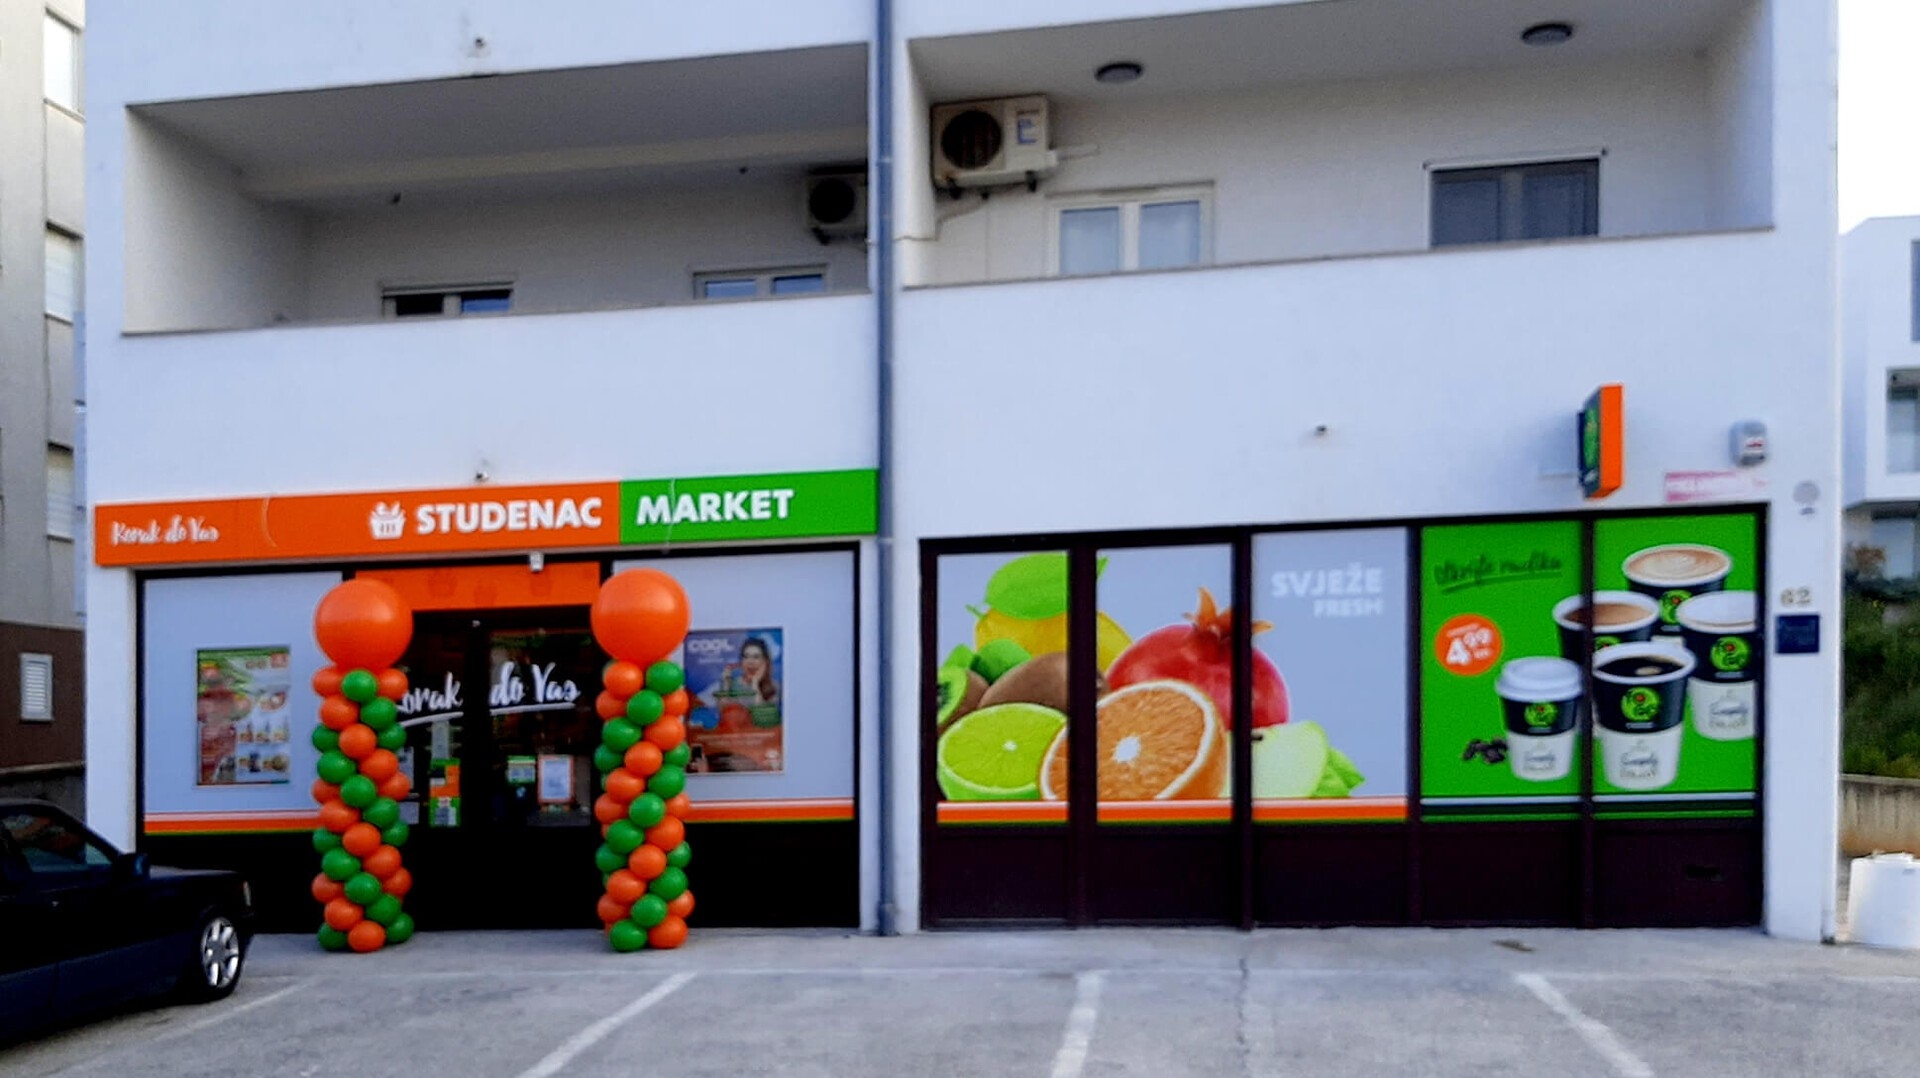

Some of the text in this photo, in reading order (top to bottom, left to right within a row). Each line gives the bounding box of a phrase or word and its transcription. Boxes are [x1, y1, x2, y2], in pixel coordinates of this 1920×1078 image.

[164, 514, 187, 543] do
[416, 489, 795, 535] STUDENAC MARKET
[1271, 562, 1383, 597] SVJEŽE
[396, 660, 581, 714] orak do Vas
